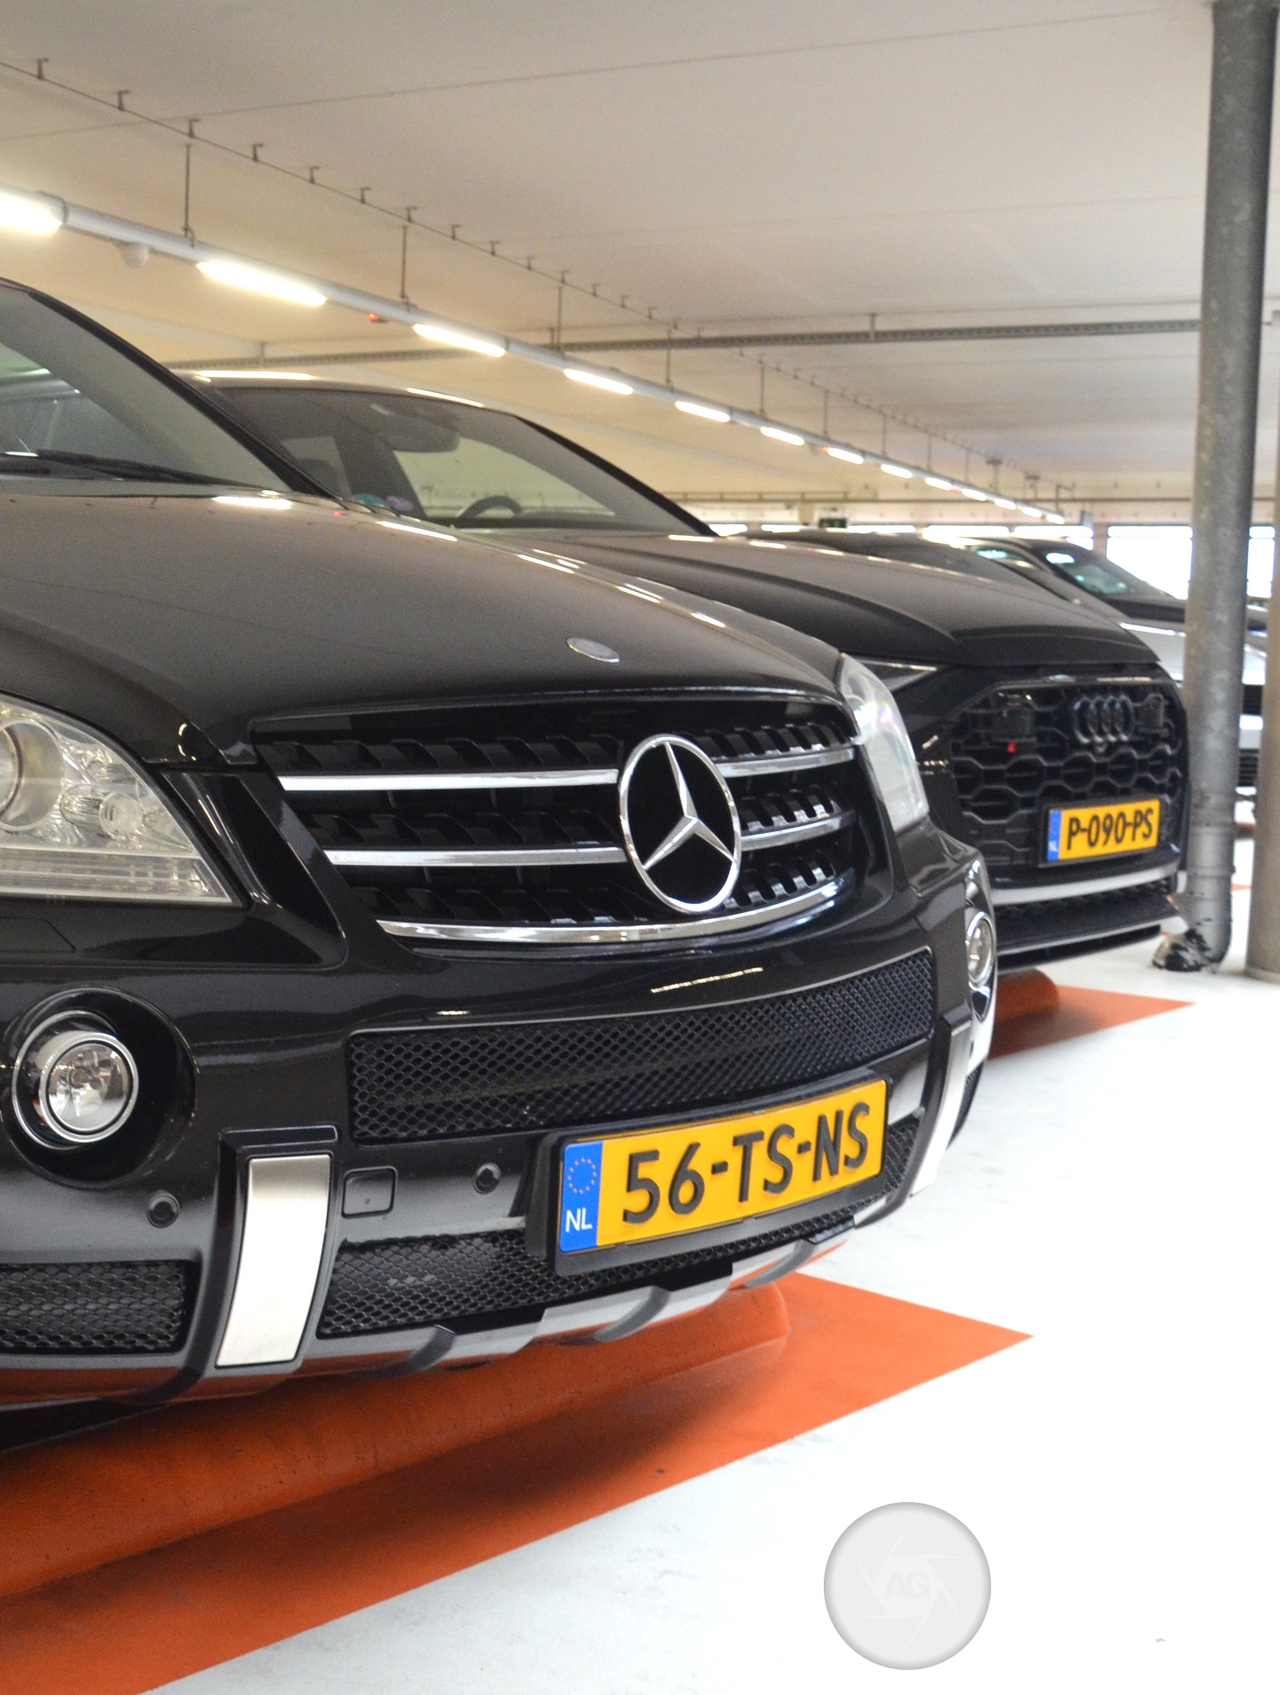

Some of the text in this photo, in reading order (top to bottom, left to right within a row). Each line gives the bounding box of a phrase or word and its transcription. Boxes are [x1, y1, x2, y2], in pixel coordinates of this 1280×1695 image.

[1066, 807, 1154, 850] P-090-PS
[565, 1102, 870, 1233] NL 56-TS-NS
